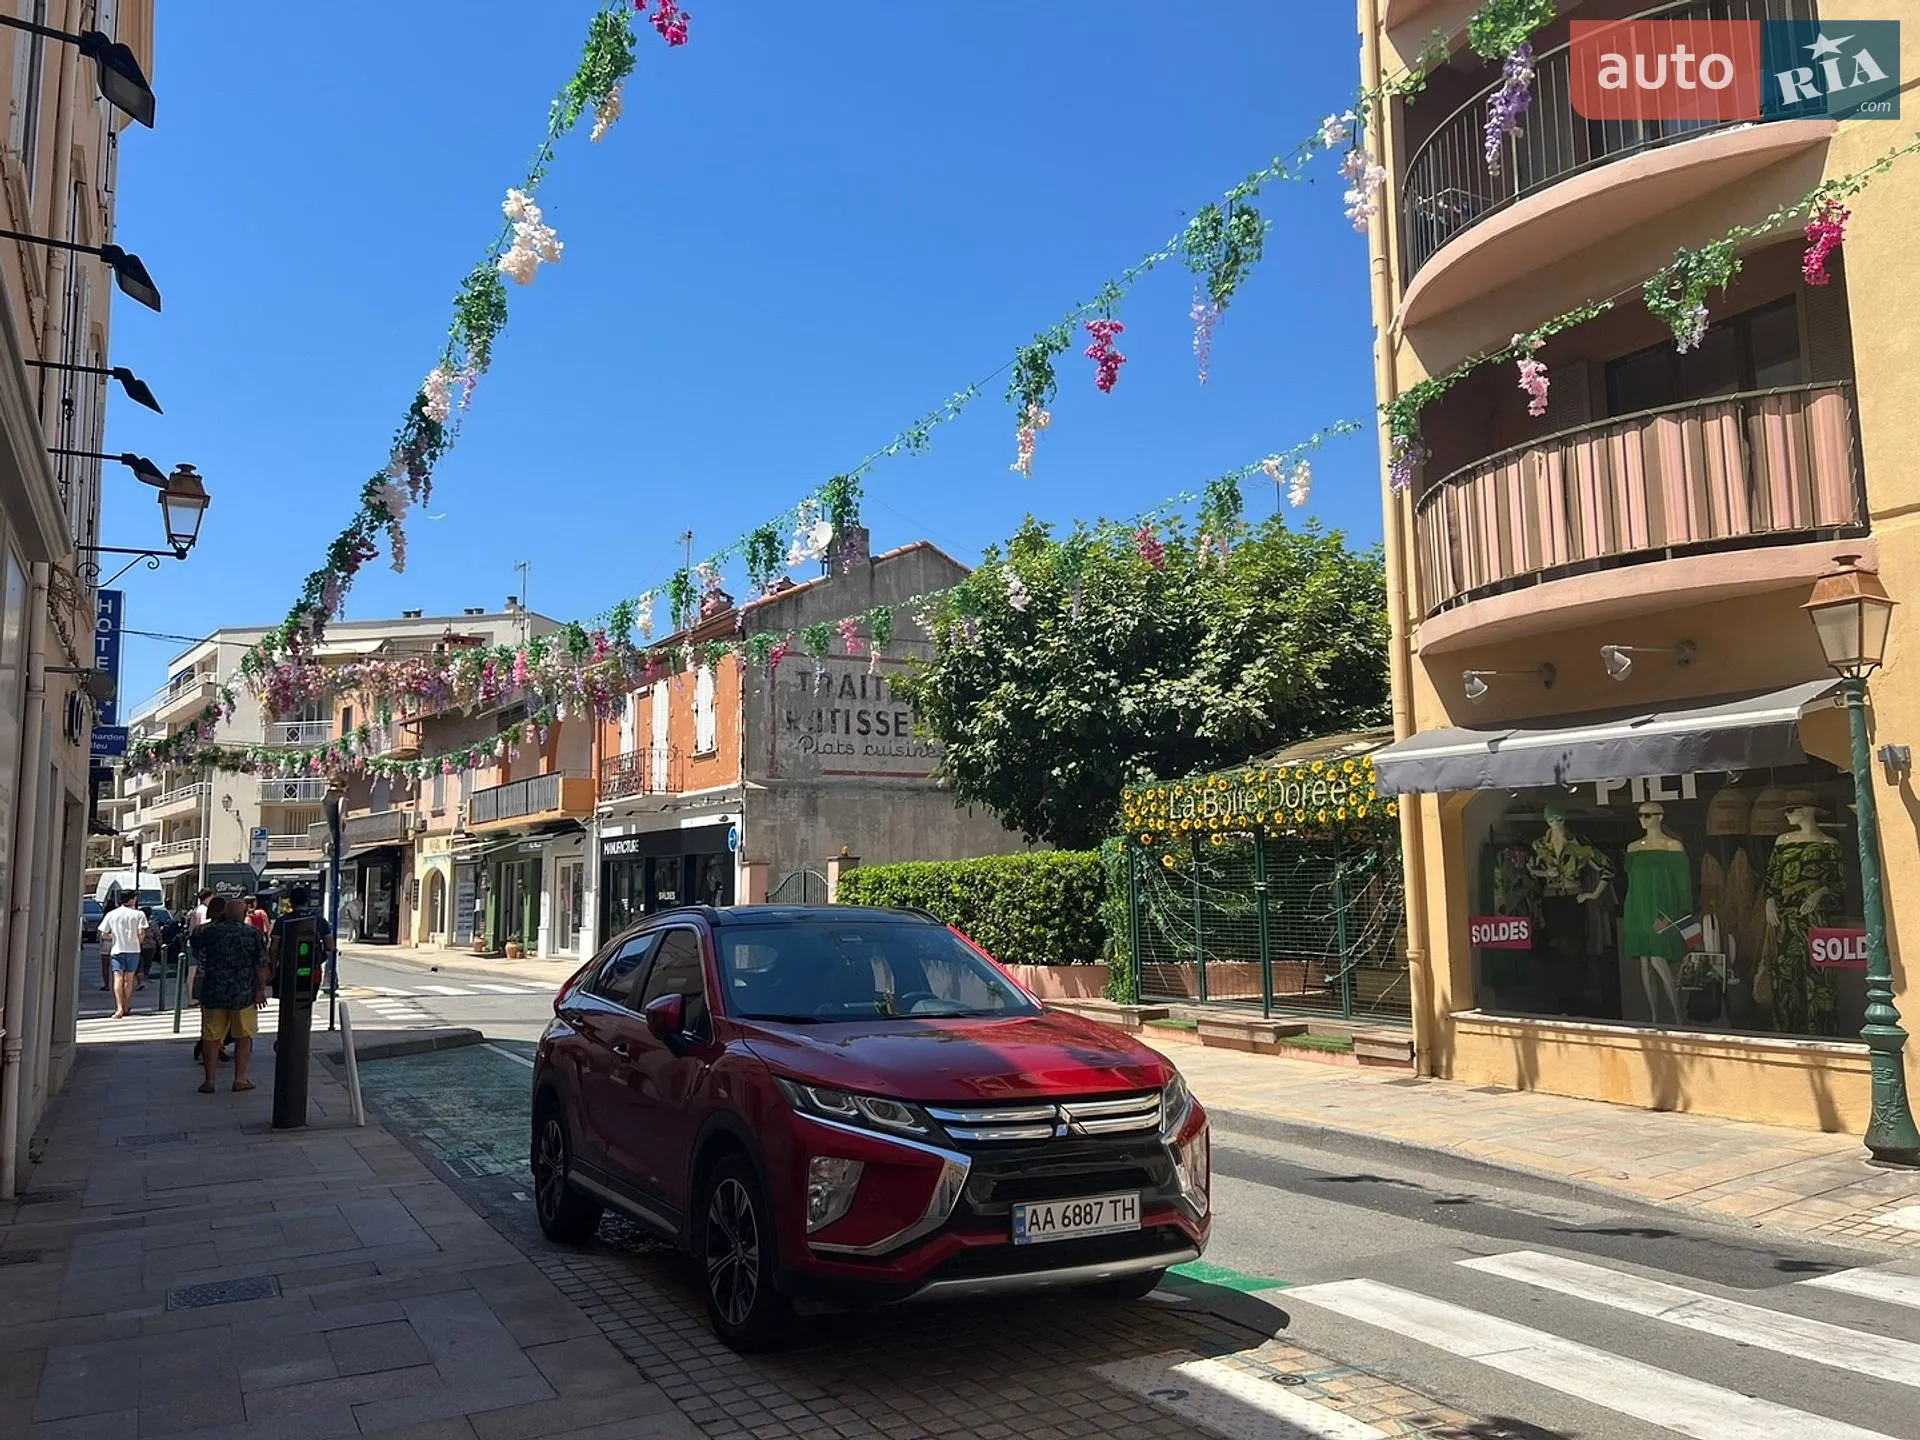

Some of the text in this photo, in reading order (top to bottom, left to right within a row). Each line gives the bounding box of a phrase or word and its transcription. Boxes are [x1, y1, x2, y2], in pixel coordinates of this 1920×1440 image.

[96, 598, 112, 672] HOTE
[91, 732, 125, 742] hardon
[93, 742, 108, 750] leu
[799, 735, 855, 756] Plats
[1170, 791, 1196, 819] La
[1471, 920, 1529, 943] SOLDES
[1812, 936, 1868, 961] SOLD
[1028, 1198, 1135, 1232] AA 6887 TH
